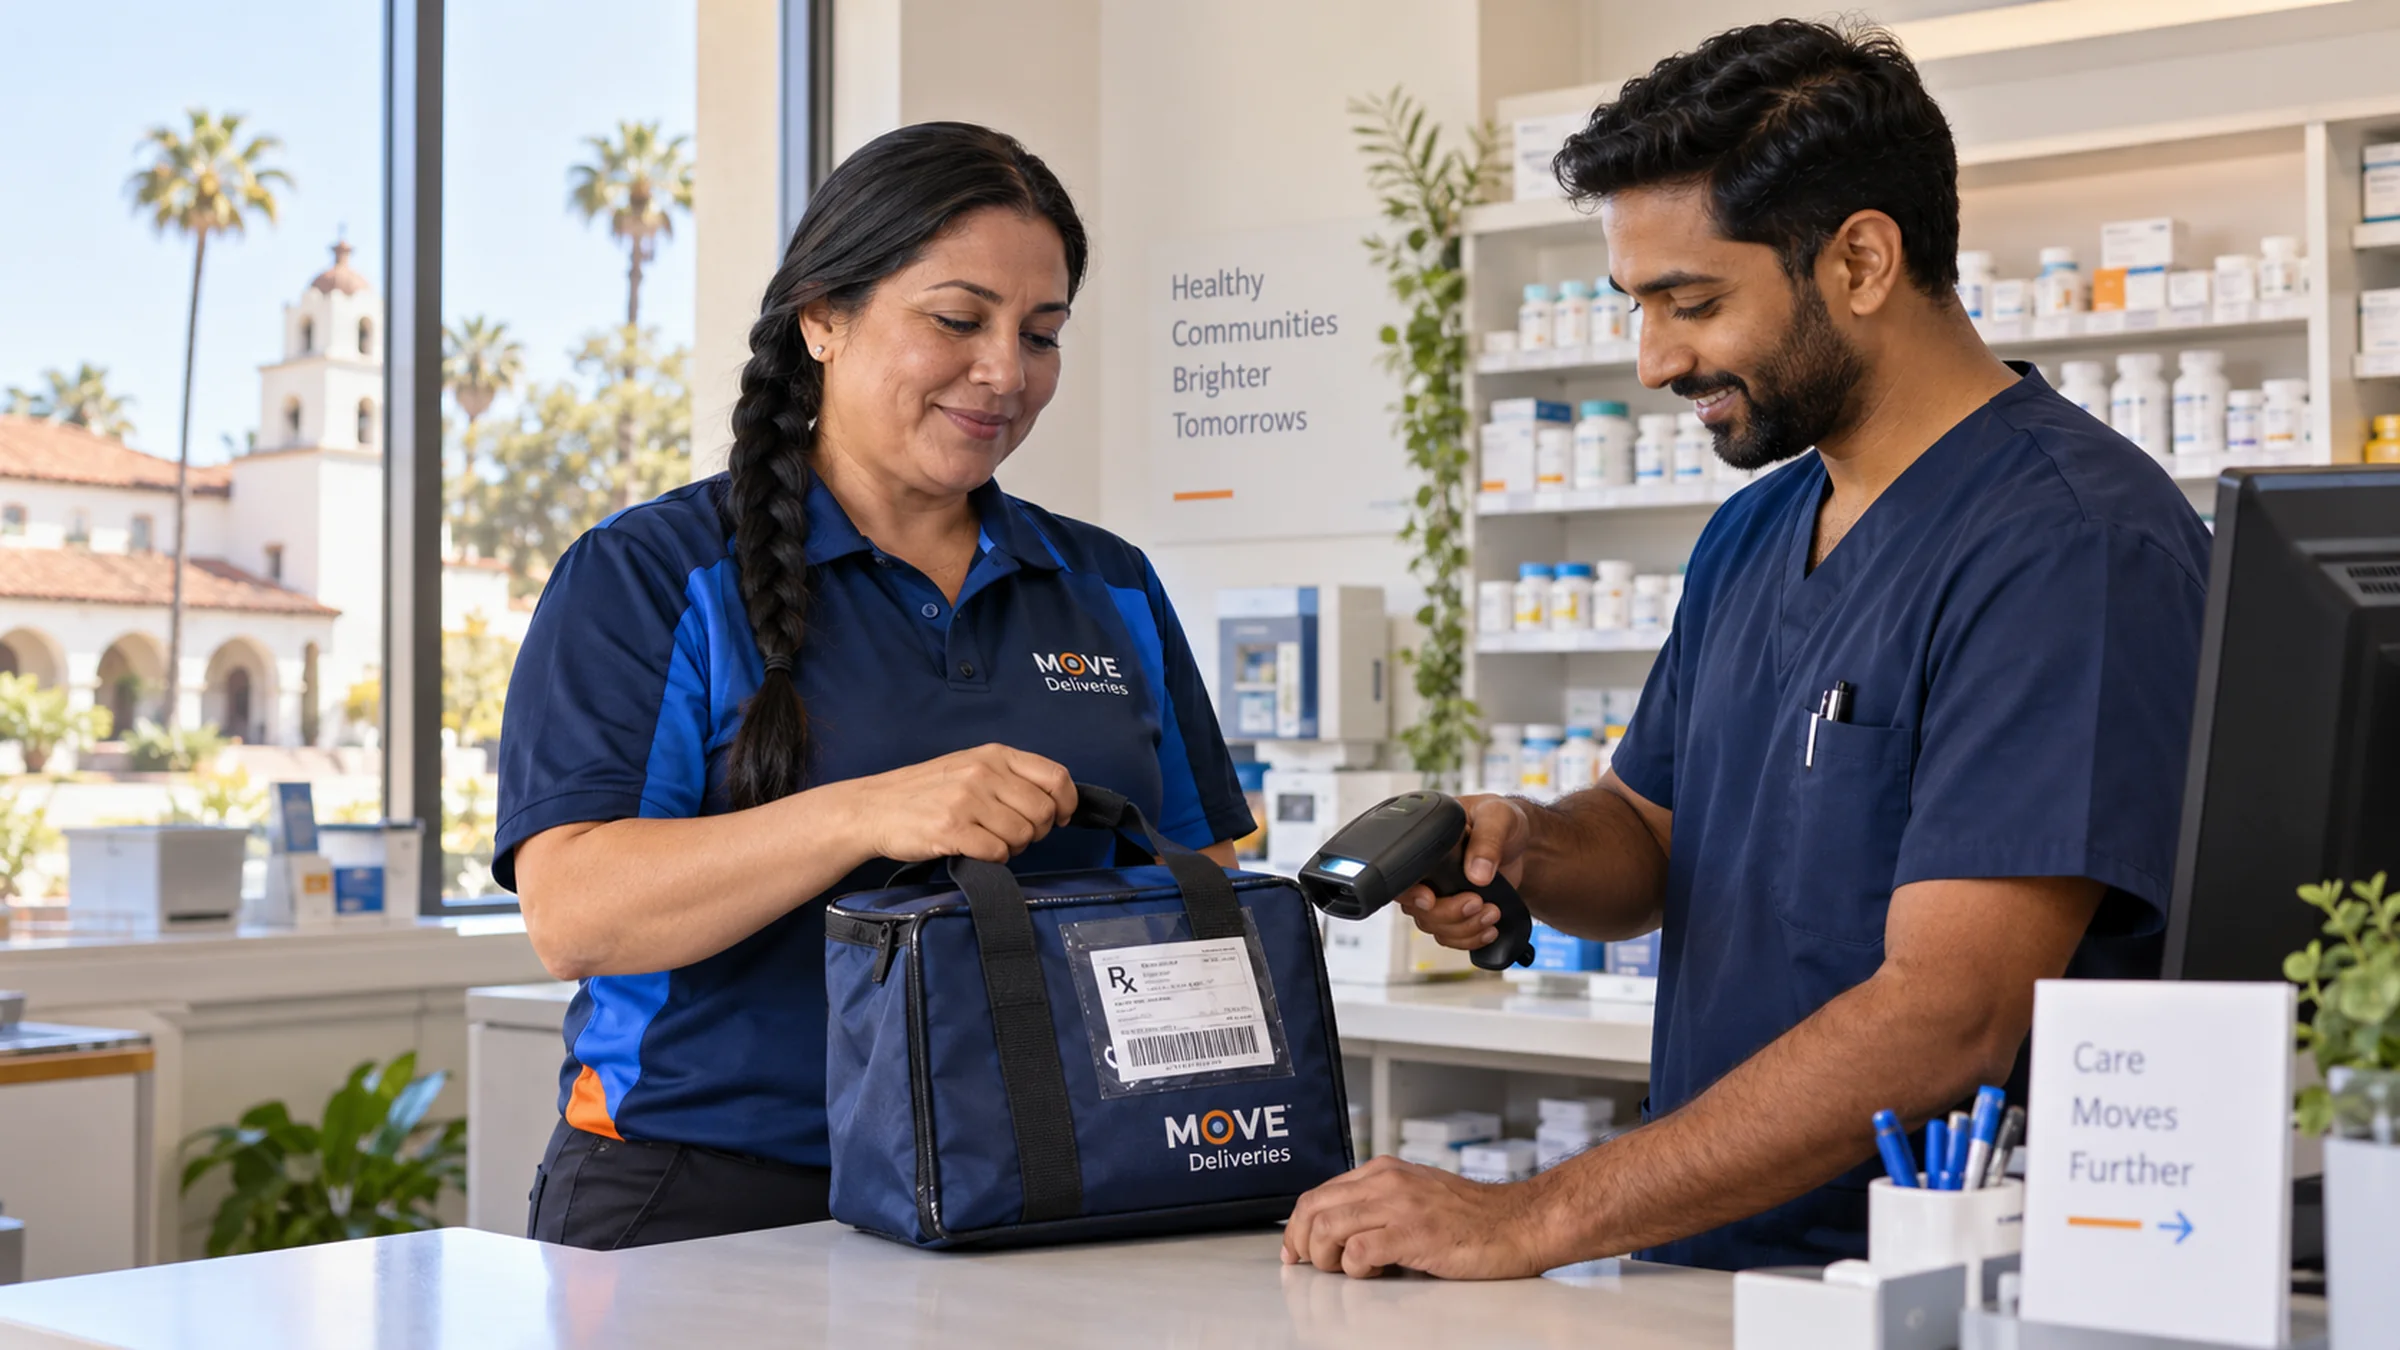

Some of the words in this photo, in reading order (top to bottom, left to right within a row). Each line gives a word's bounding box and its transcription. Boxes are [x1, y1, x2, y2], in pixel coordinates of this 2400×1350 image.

[1172, 267, 1264, 301] Healthy
[1172, 310, 1338, 347] Communities
[1173, 361, 1271, 398] Brighter
[1173, 410, 1307, 438] Tomorrows
[1032, 652, 1122, 678] MOVE
[1044, 676, 1129, 695] Deliveries
[2073, 1041, 2145, 1075] Care
[1164, 1104, 1290, 1149] MOVE
[2071, 1096, 2178, 1131] Moves
[1189, 1145, 1291, 1172] Deliveries
[2069, 1151, 2193, 1187] Further
